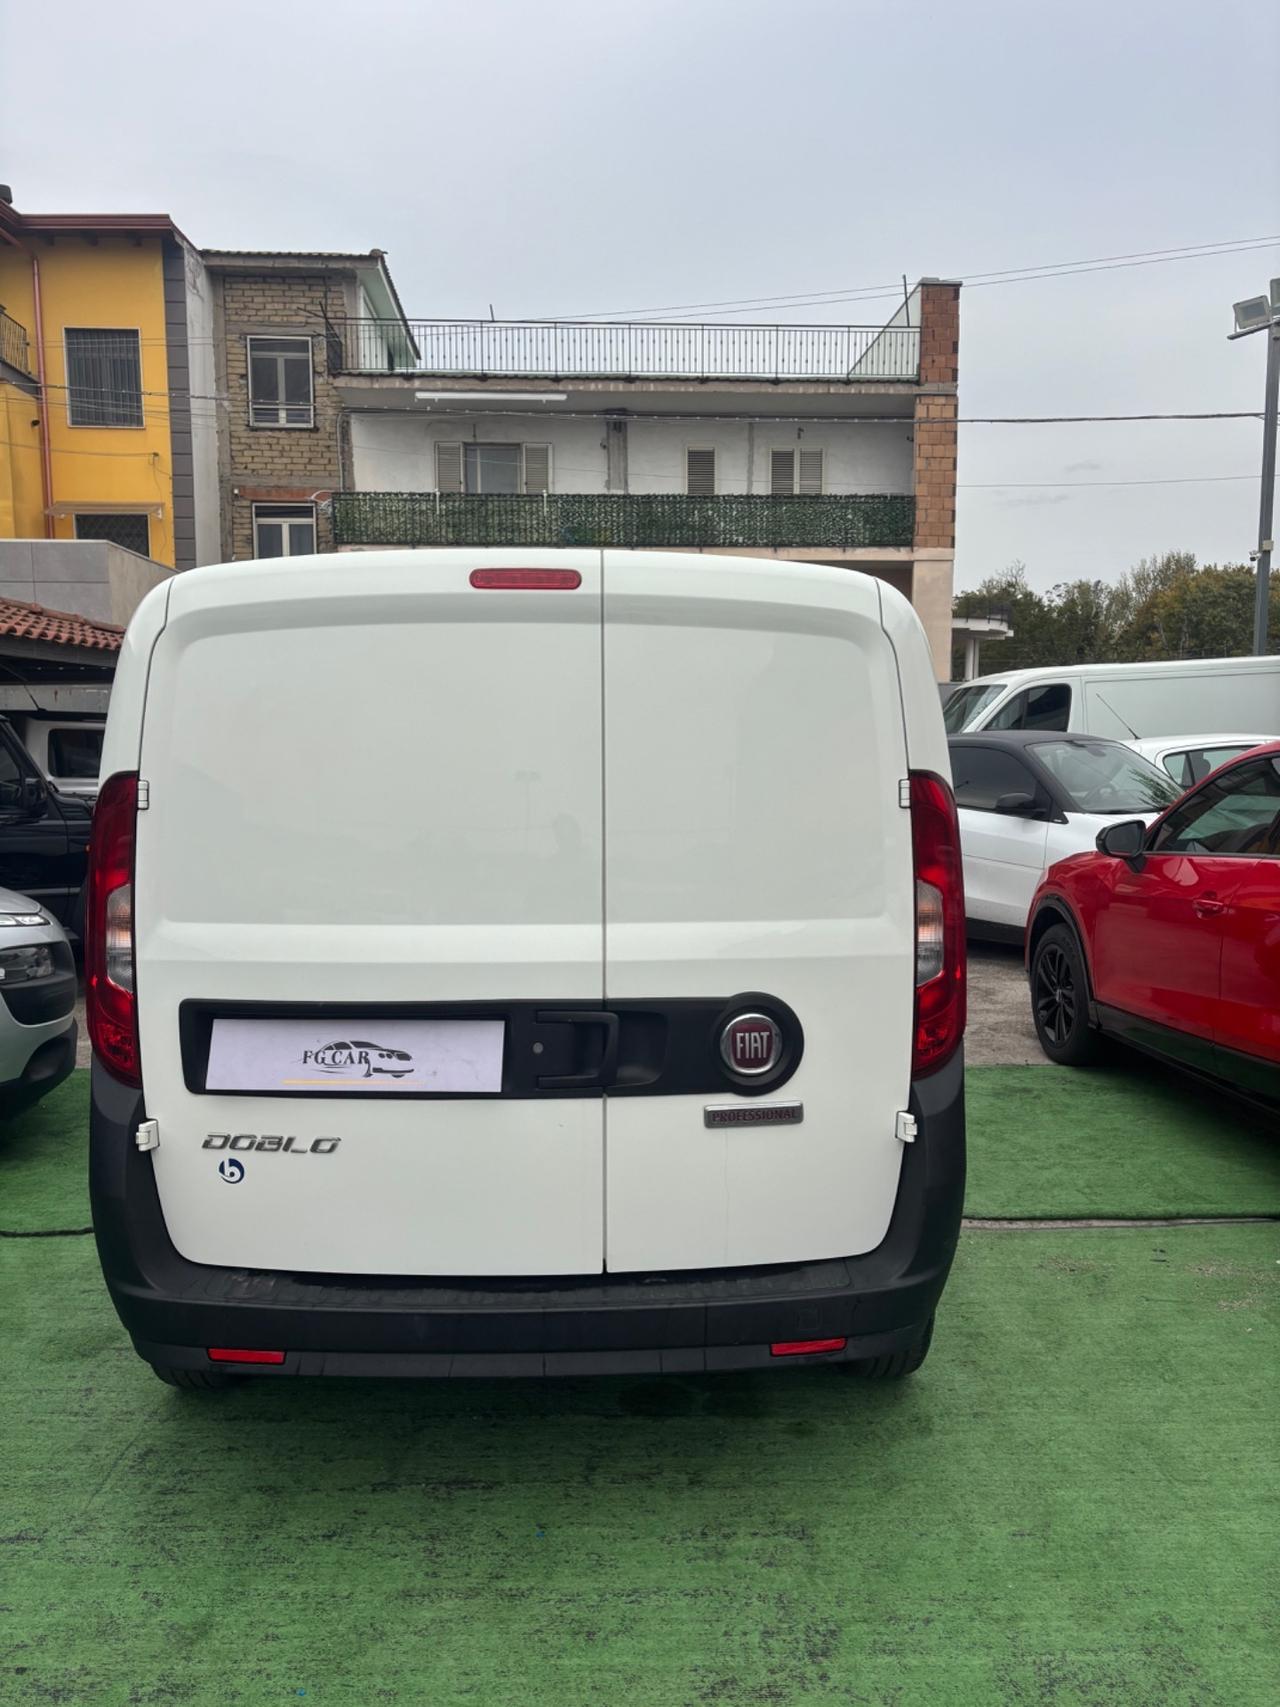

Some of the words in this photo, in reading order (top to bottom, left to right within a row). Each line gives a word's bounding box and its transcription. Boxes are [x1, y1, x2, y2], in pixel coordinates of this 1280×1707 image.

[735, 1031, 770, 1059] FIAT
[303, 1050, 326, 1065] FG
[331, 1050, 371, 1067] CAR
[711, 1108, 798, 1123] PROFESSIONAL
